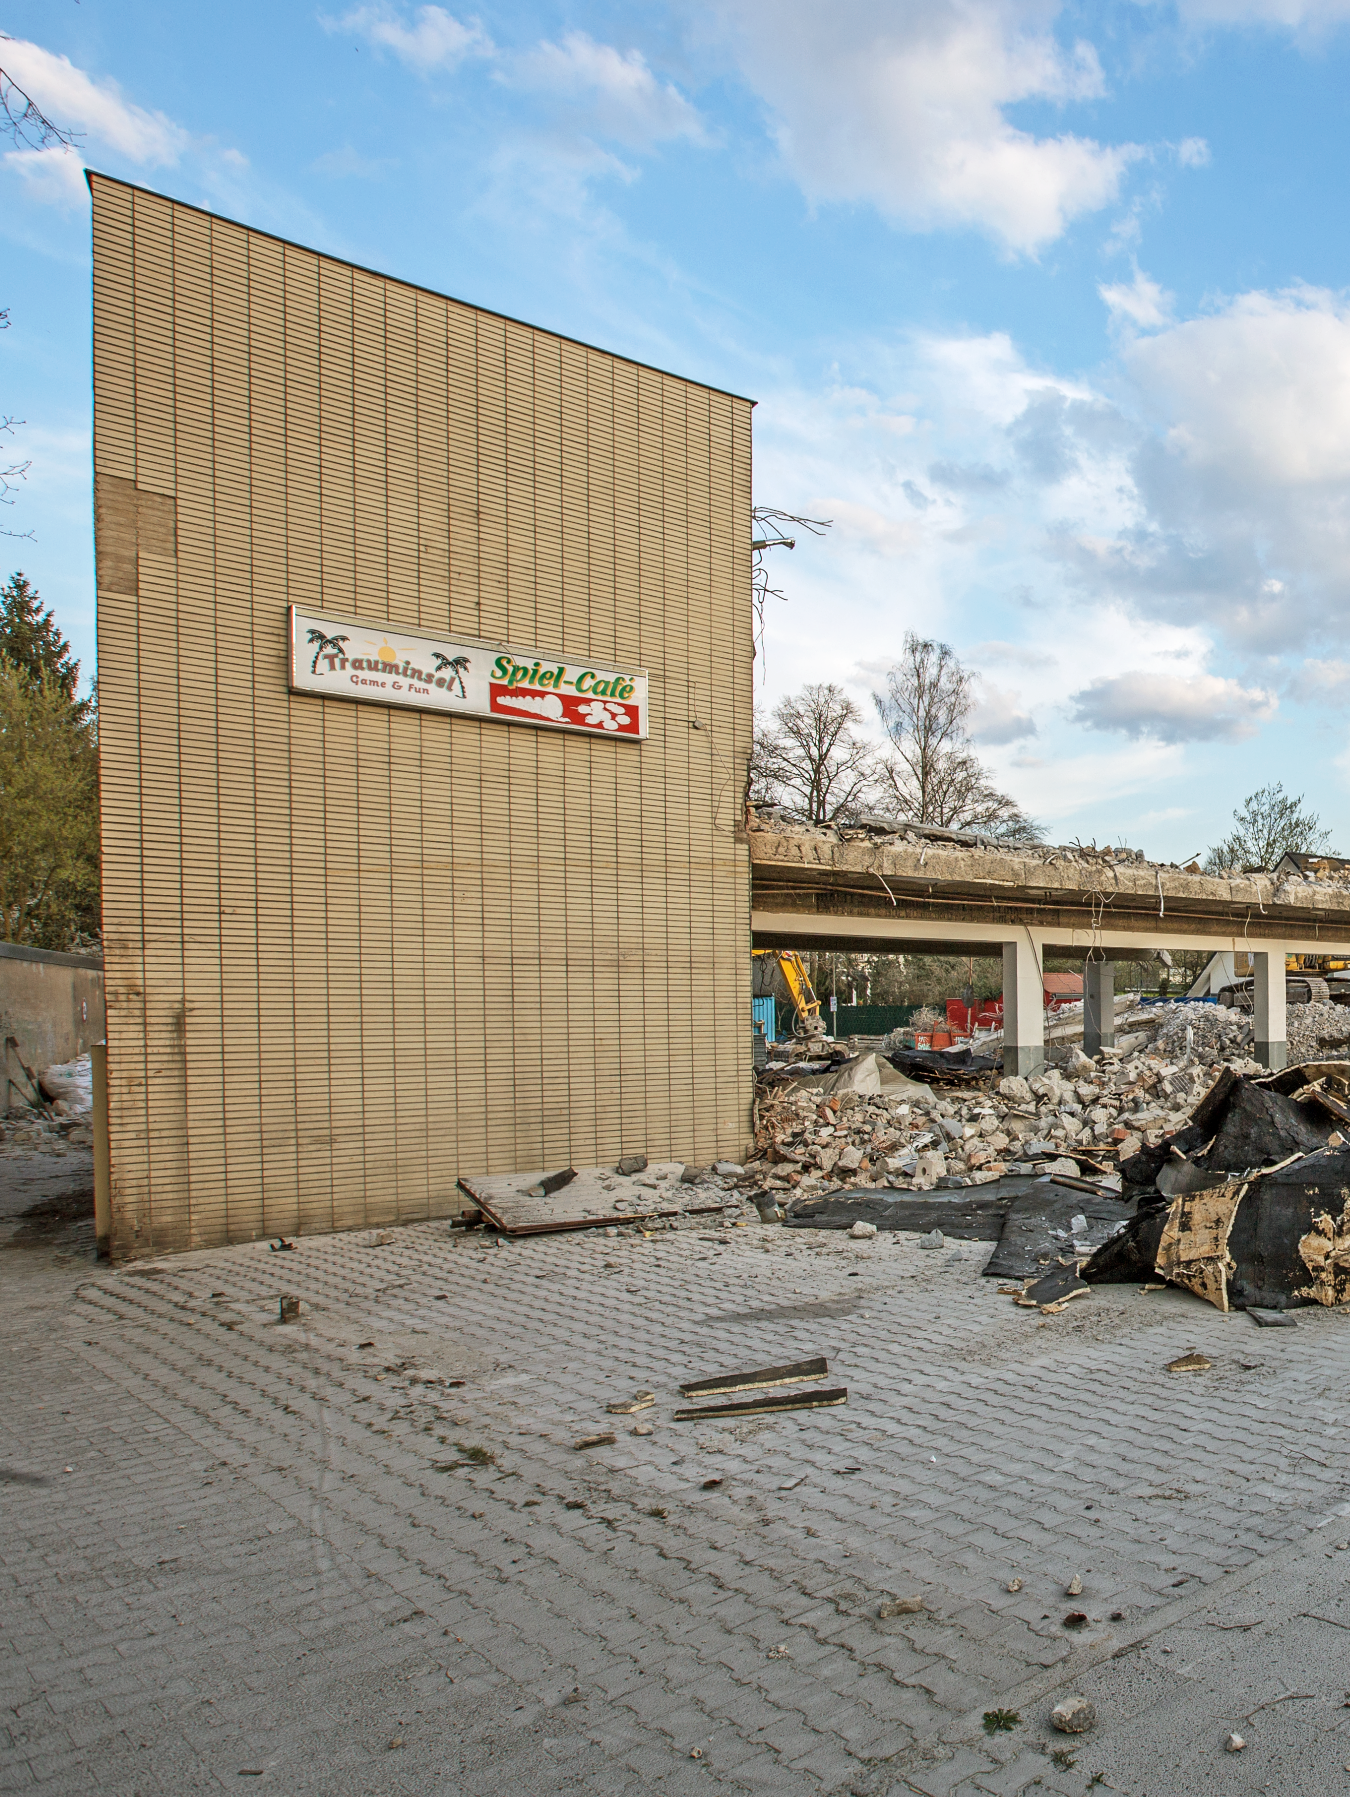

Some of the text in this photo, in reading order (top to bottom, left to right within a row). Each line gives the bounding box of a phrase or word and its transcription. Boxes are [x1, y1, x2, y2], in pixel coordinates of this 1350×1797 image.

[322, 652, 458, 692] Trauminsel
[350, 674, 430, 695] Game & Fun
[490, 656, 636, 701] Spiel-Café
